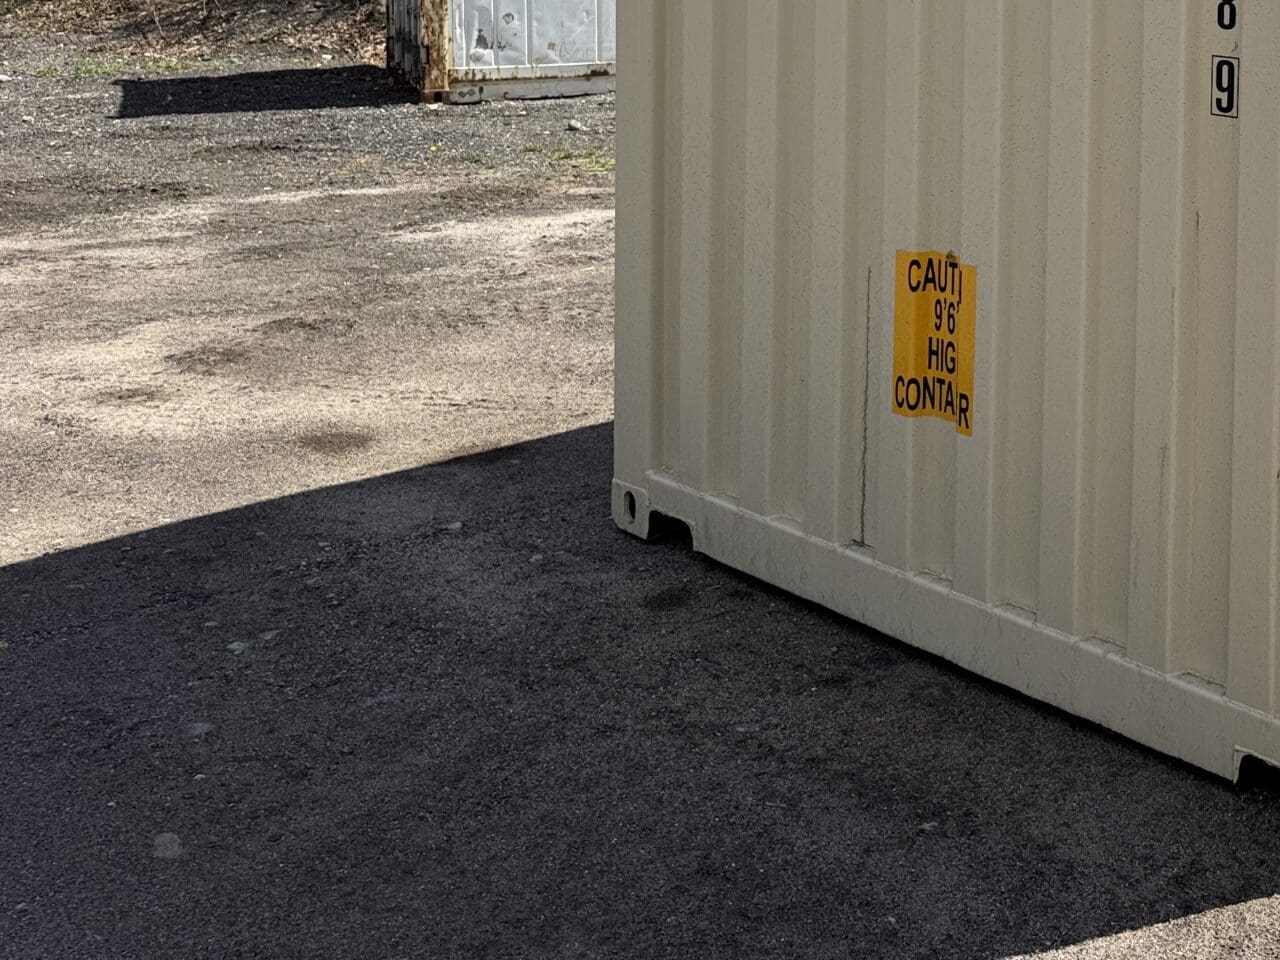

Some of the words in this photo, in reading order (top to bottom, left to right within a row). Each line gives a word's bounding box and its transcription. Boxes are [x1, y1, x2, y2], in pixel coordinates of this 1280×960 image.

[1214, 60, 1236, 116] 9
[927, 336, 957, 375] HIG
[895, 375, 970, 429] CONTAR
